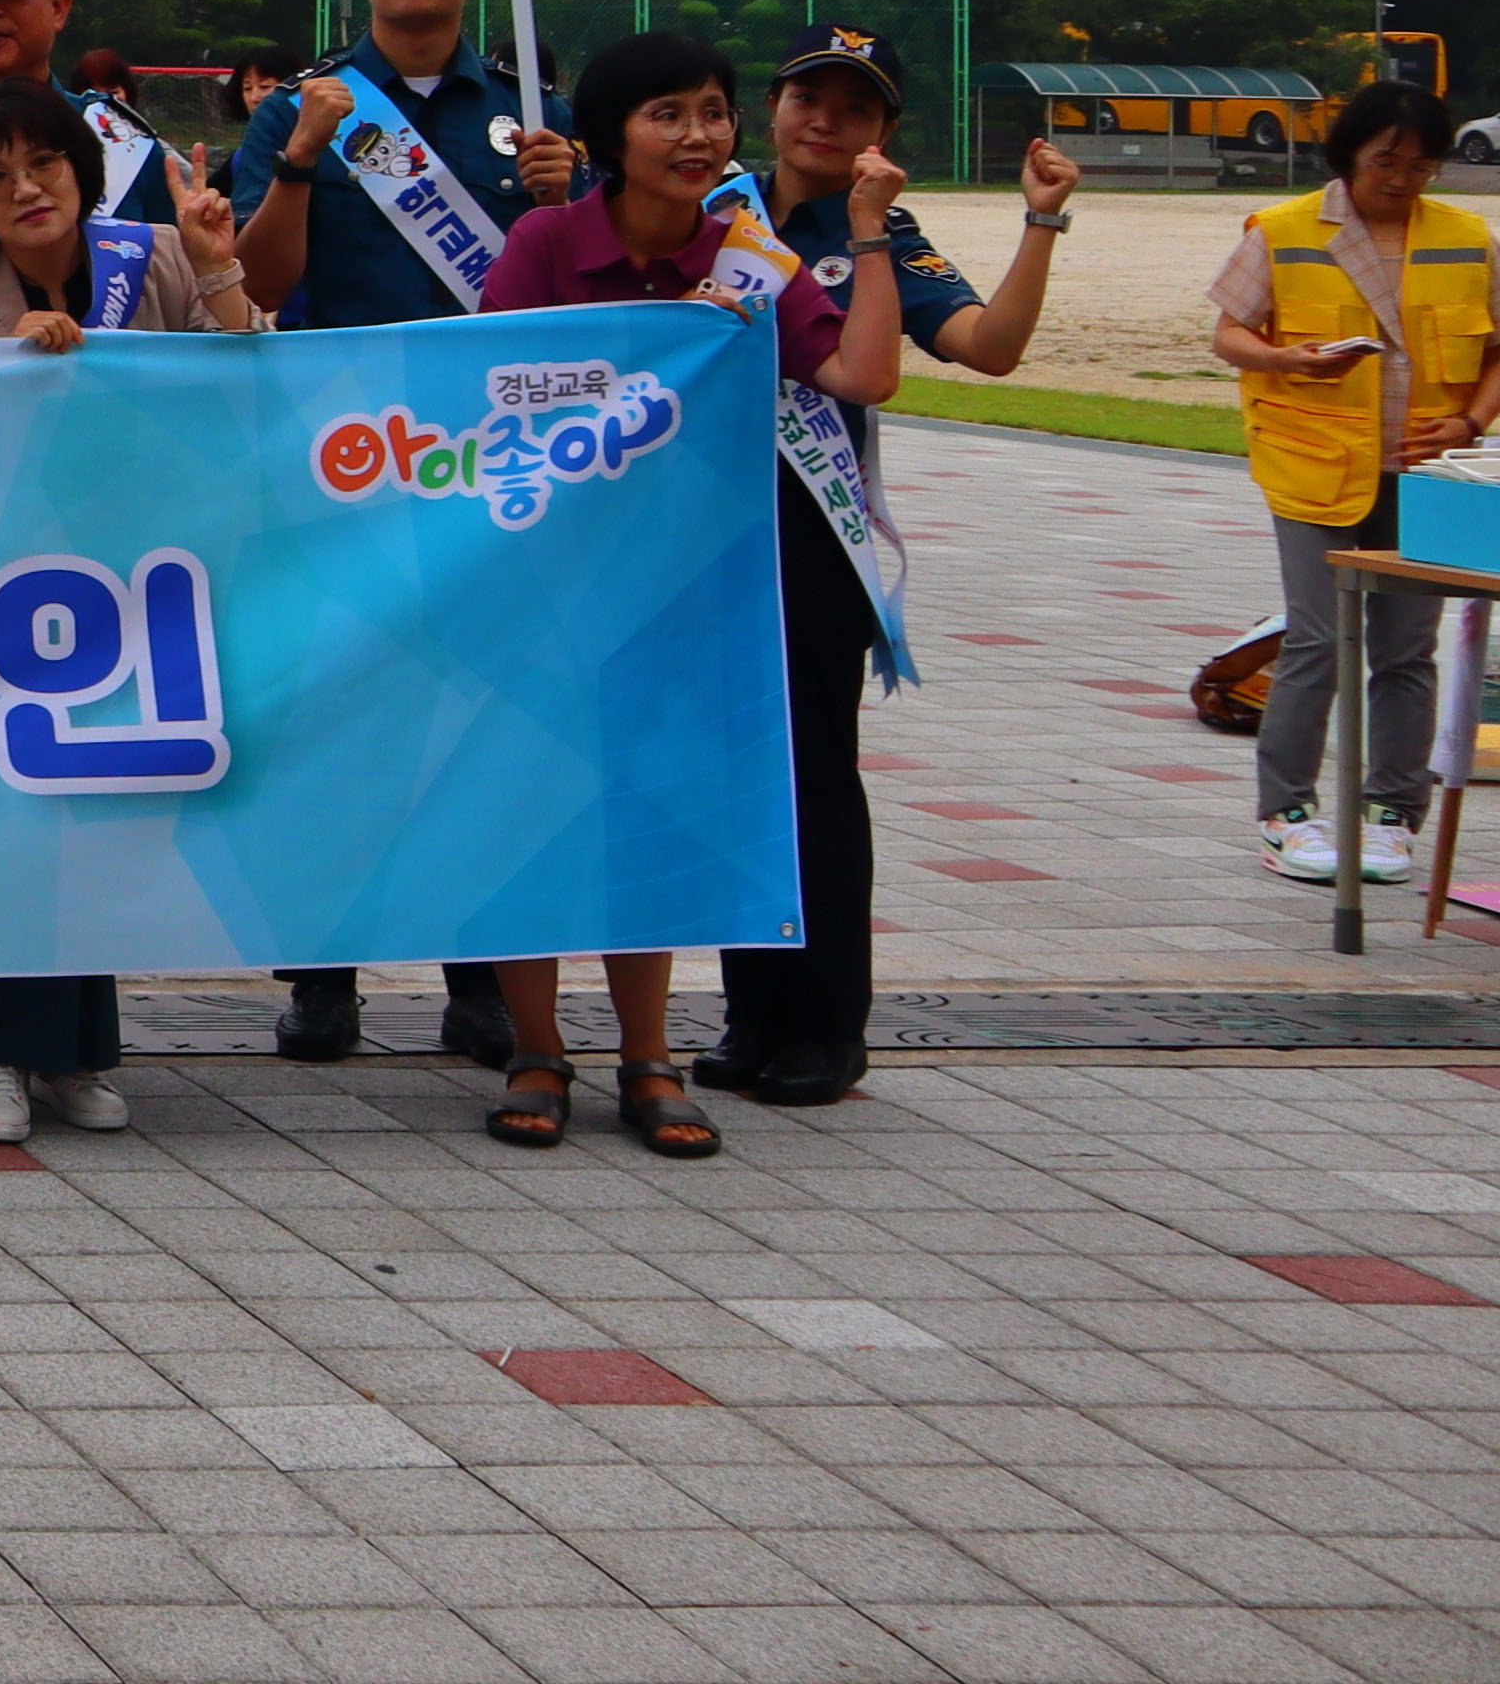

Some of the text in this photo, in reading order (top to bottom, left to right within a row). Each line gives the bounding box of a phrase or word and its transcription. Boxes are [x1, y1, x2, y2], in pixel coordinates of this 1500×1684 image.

[395, 177, 499, 292] 학교폭
[100, 272, 131, 331] 소중
[495, 369, 611, 405] 경남교육
[792, 383, 842, 442] 함께
[320, 395, 674, 522] 아이좋아
[822, 478, 865, 546] 세상
